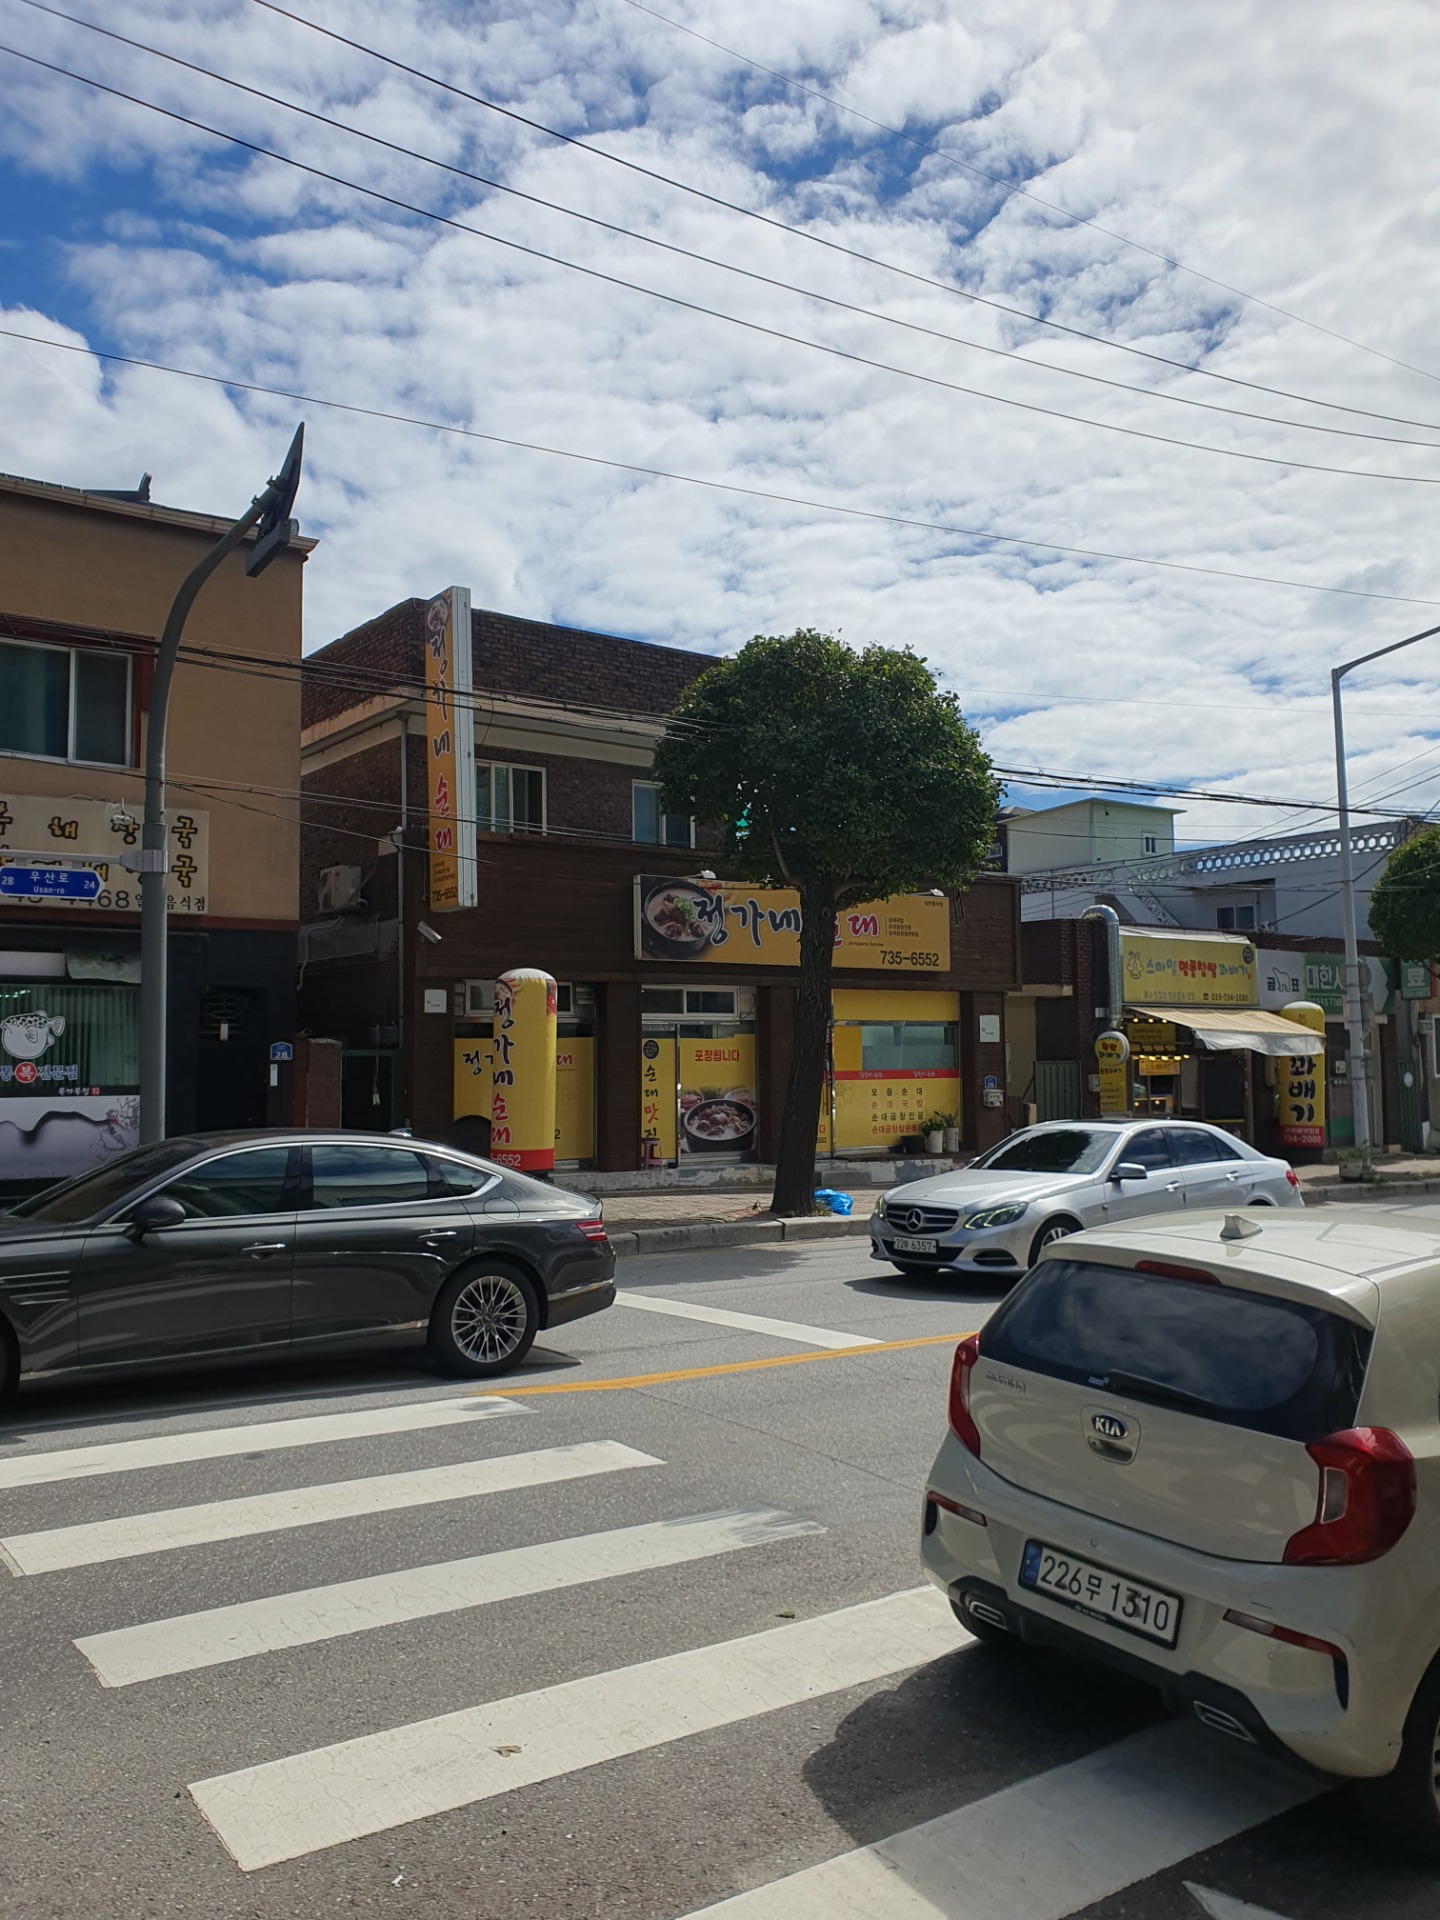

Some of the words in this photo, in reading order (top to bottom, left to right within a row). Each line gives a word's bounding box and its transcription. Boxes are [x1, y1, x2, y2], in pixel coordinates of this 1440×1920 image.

[2, 876, 14, 887] 28
[30, 871, 70, 884] 우산로
[33, 885, 65, 895] Usan-ro
[84, 879, 96, 890] 24
[880, 950, 940, 967] 735-6552
[1146, 959, 1176, 976] 스마일
[1178, 959, 1217, 978] 명품찹쌀
[1267, 976, 1276, 991] 곰
[1290, 977, 1301, 992] 표
[1211, 992, 1249, 1002] 033-734-2080
[274, 1050, 288, 1059] 28
[695, 1049, 740, 1062] 포장됩니다
[1282, 1133, 1322, 1143] 734-2080
[911, 1240, 932, 1251] 6357
[1095, 1416, 1121, 1437] KIA
[1041, 1555, 1102, 1601] 226무
[1111, 1582, 1170, 1631] 1310
